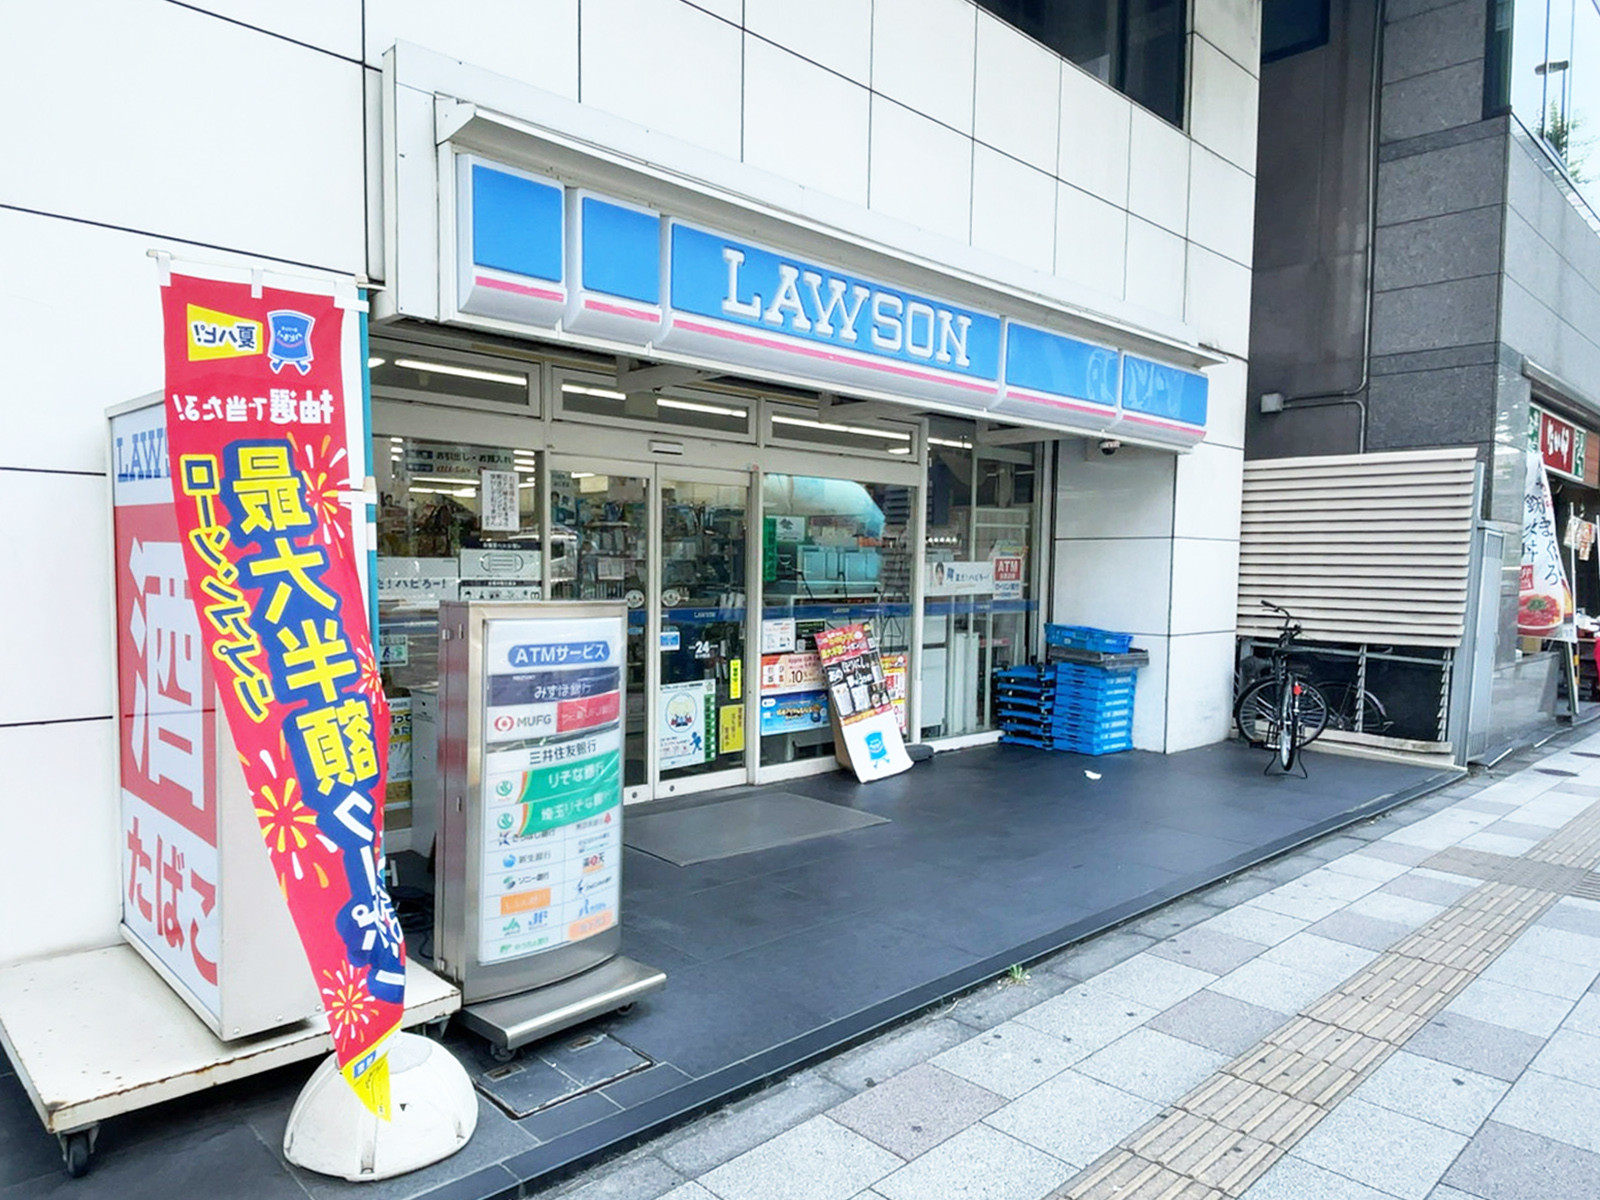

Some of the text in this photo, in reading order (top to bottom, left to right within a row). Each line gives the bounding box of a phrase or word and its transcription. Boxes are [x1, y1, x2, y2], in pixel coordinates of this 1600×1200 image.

[722, 246, 972, 368] LAWSON
[116, 427, 169, 483] LAW
[1539, 516, 1559, 587] まぐろ
[997, 561, 1019, 573] ATM
[515, 644, 606, 664] ATMサービス
[695, 641, 710, 654] 24
[534, 682, 591, 699] みずほ銀行
[517, 714, 552, 728] MUFG
[530, 740, 597, 765] 三井住友銀行
[548, 761, 605, 788] りそな銀行
[127, 816, 218, 987] たばこ
